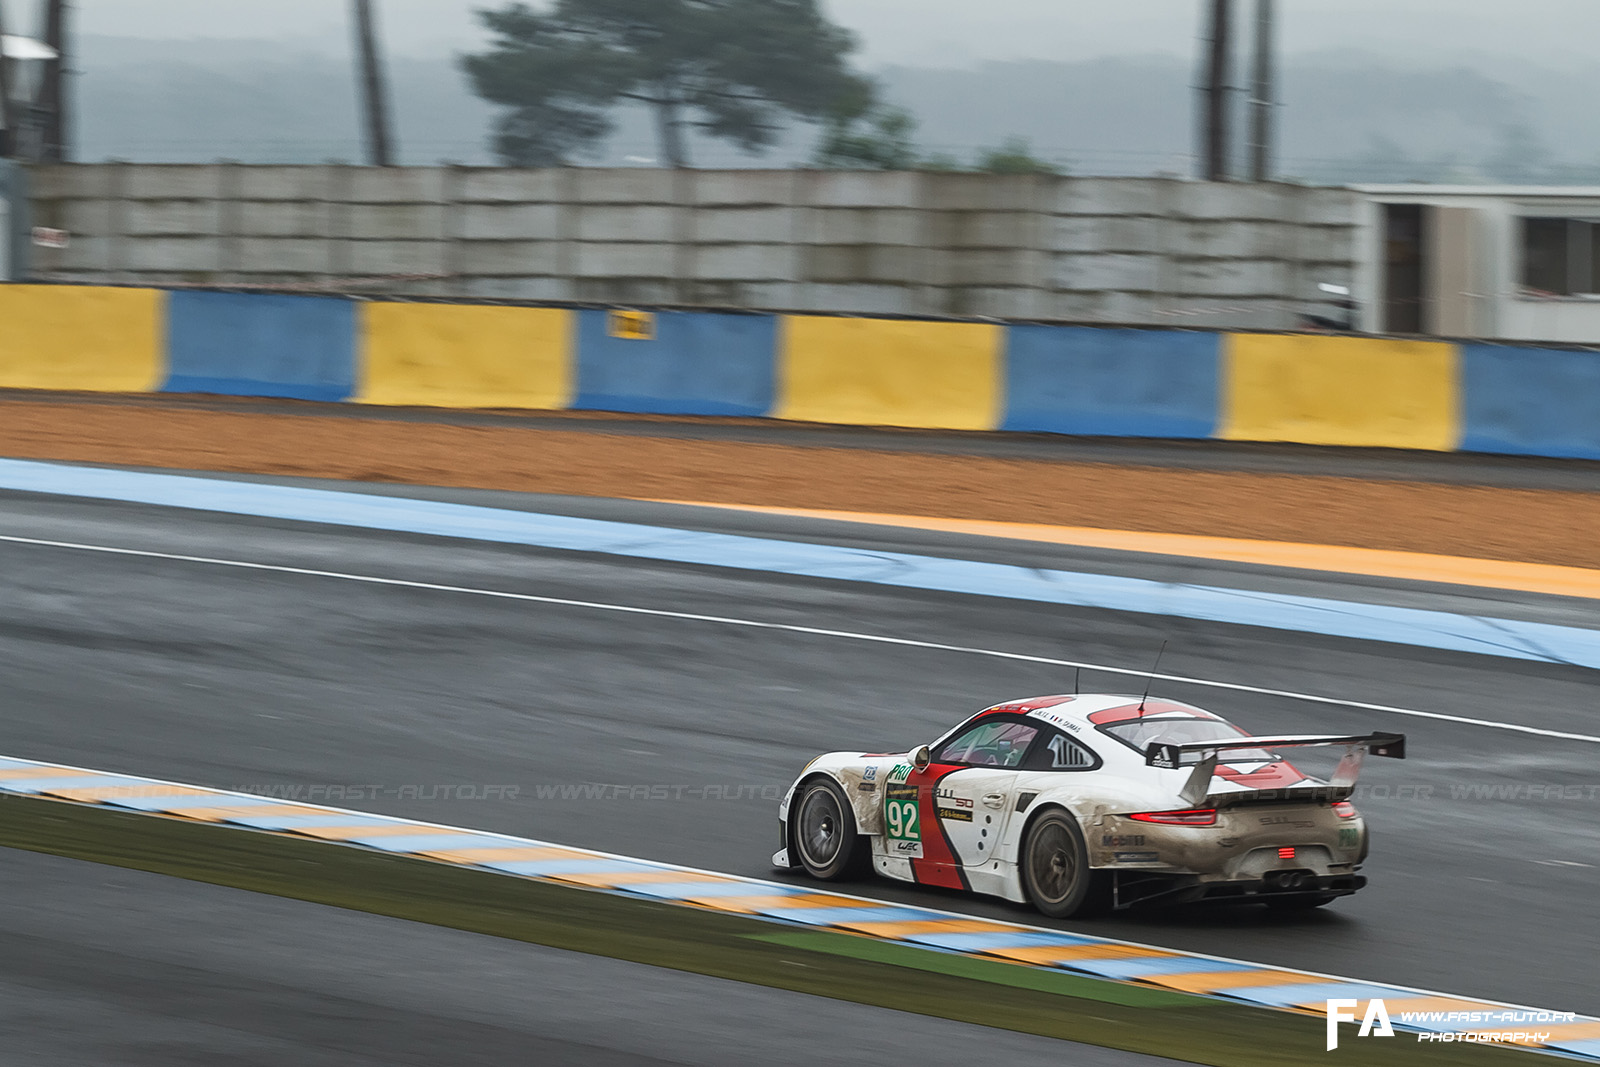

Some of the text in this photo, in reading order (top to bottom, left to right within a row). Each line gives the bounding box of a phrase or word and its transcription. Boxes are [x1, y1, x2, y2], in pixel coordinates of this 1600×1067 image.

[889, 764, 914, 780] PRO
[887, 801, 919, 838] 92
[898, 842, 918, 851] WEC
